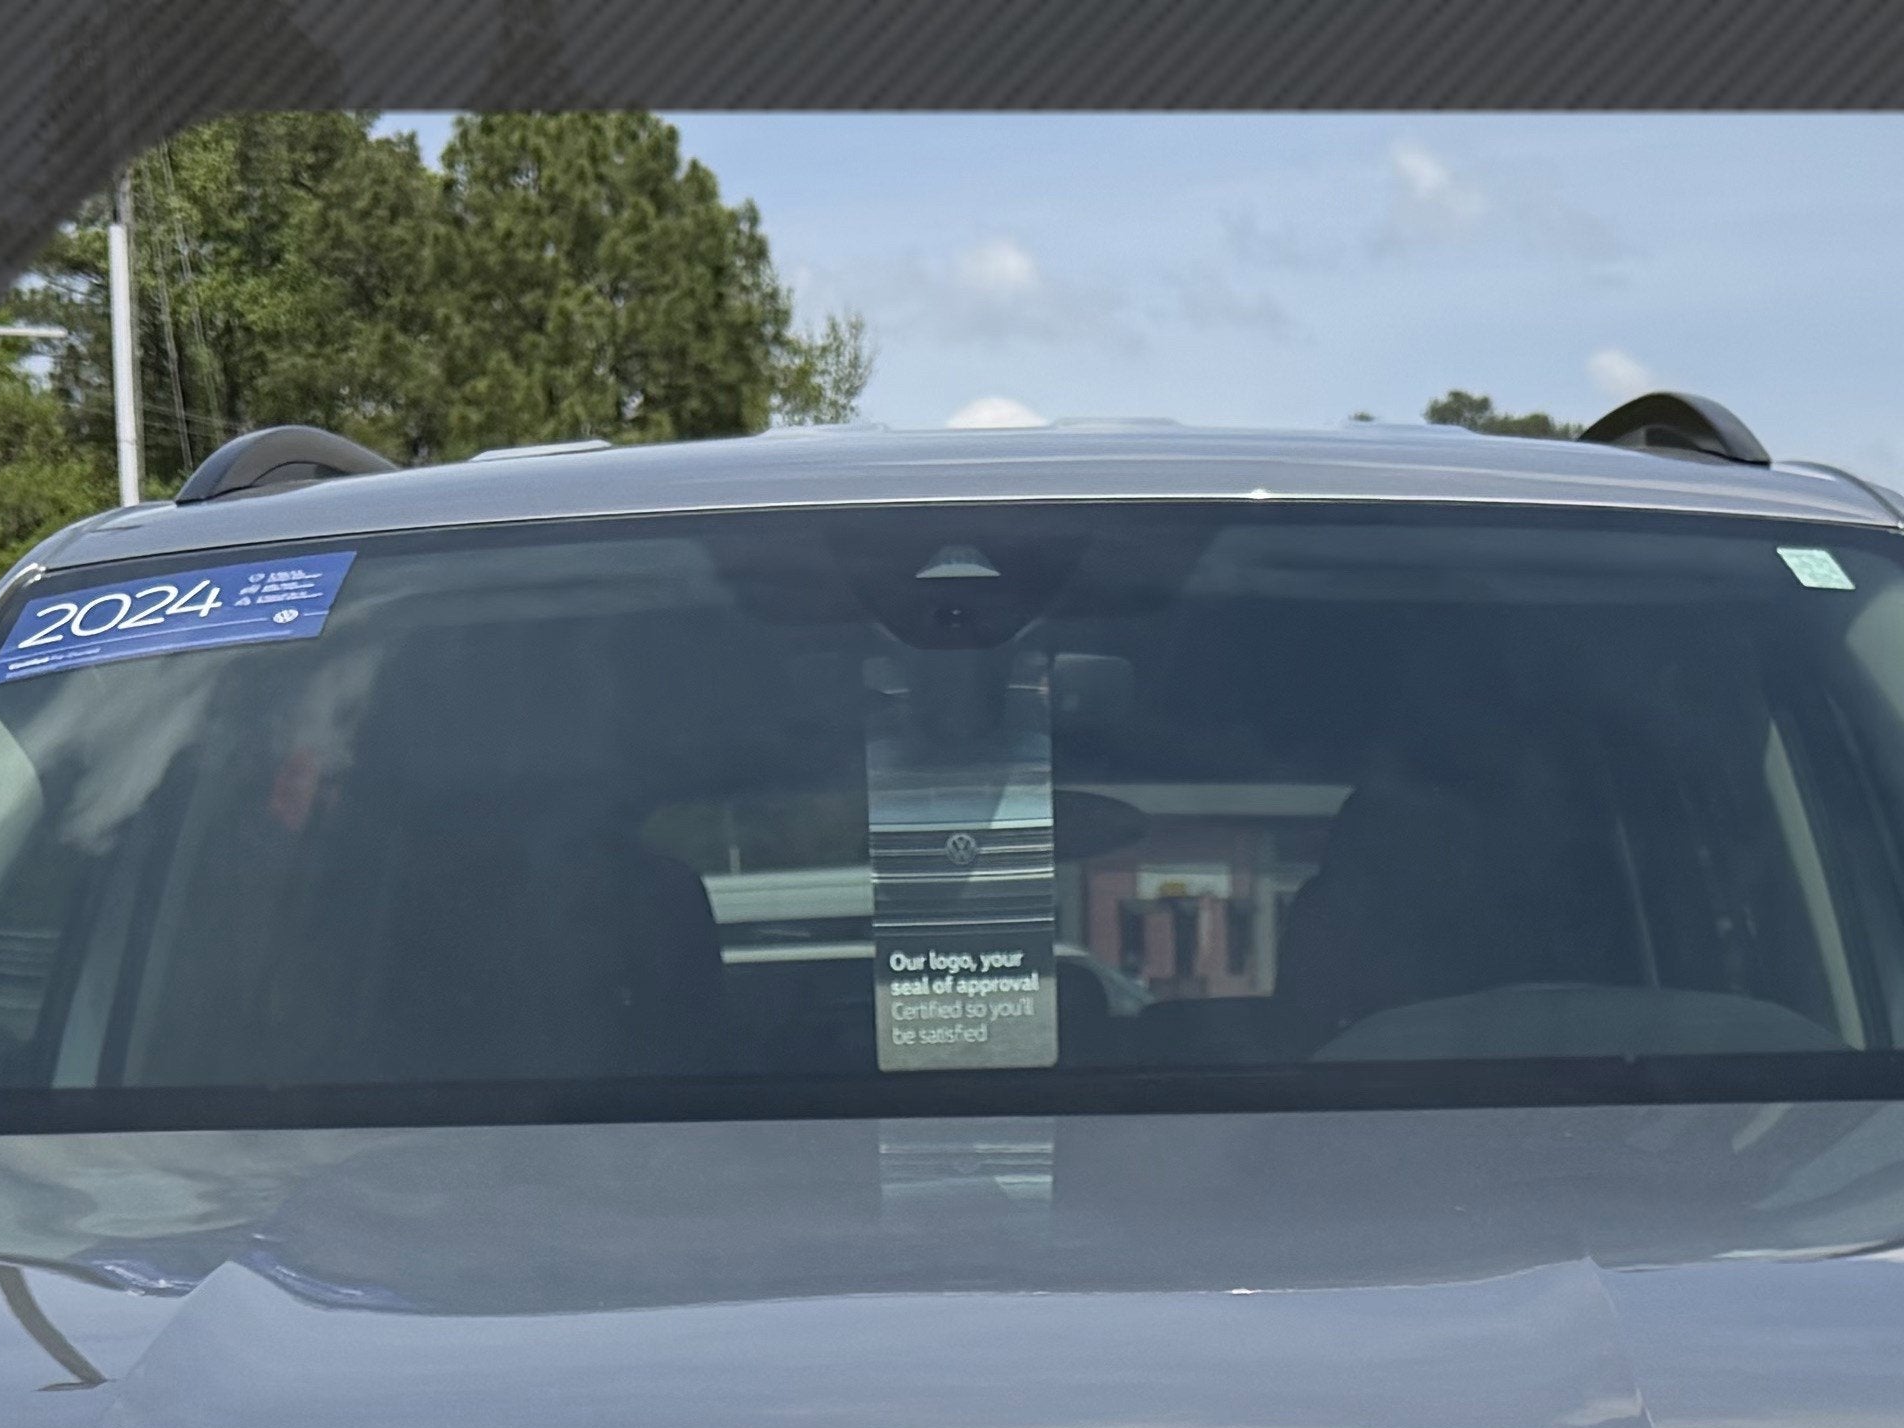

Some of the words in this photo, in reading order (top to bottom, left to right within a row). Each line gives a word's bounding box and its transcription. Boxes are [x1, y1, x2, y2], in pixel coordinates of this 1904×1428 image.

[17, 579, 222, 649] 2024
[889, 952, 927, 972] Our
[929, 949, 977, 974] logo,
[980, 952, 1024, 973] your
[890, 975, 930, 996] seal
[932, 974, 954, 994] of
[956, 971, 1040, 997] approval
[891, 999, 963, 1021] Certified
[965, 1002, 987, 1018] so
[892, 1026, 917, 1045] be
